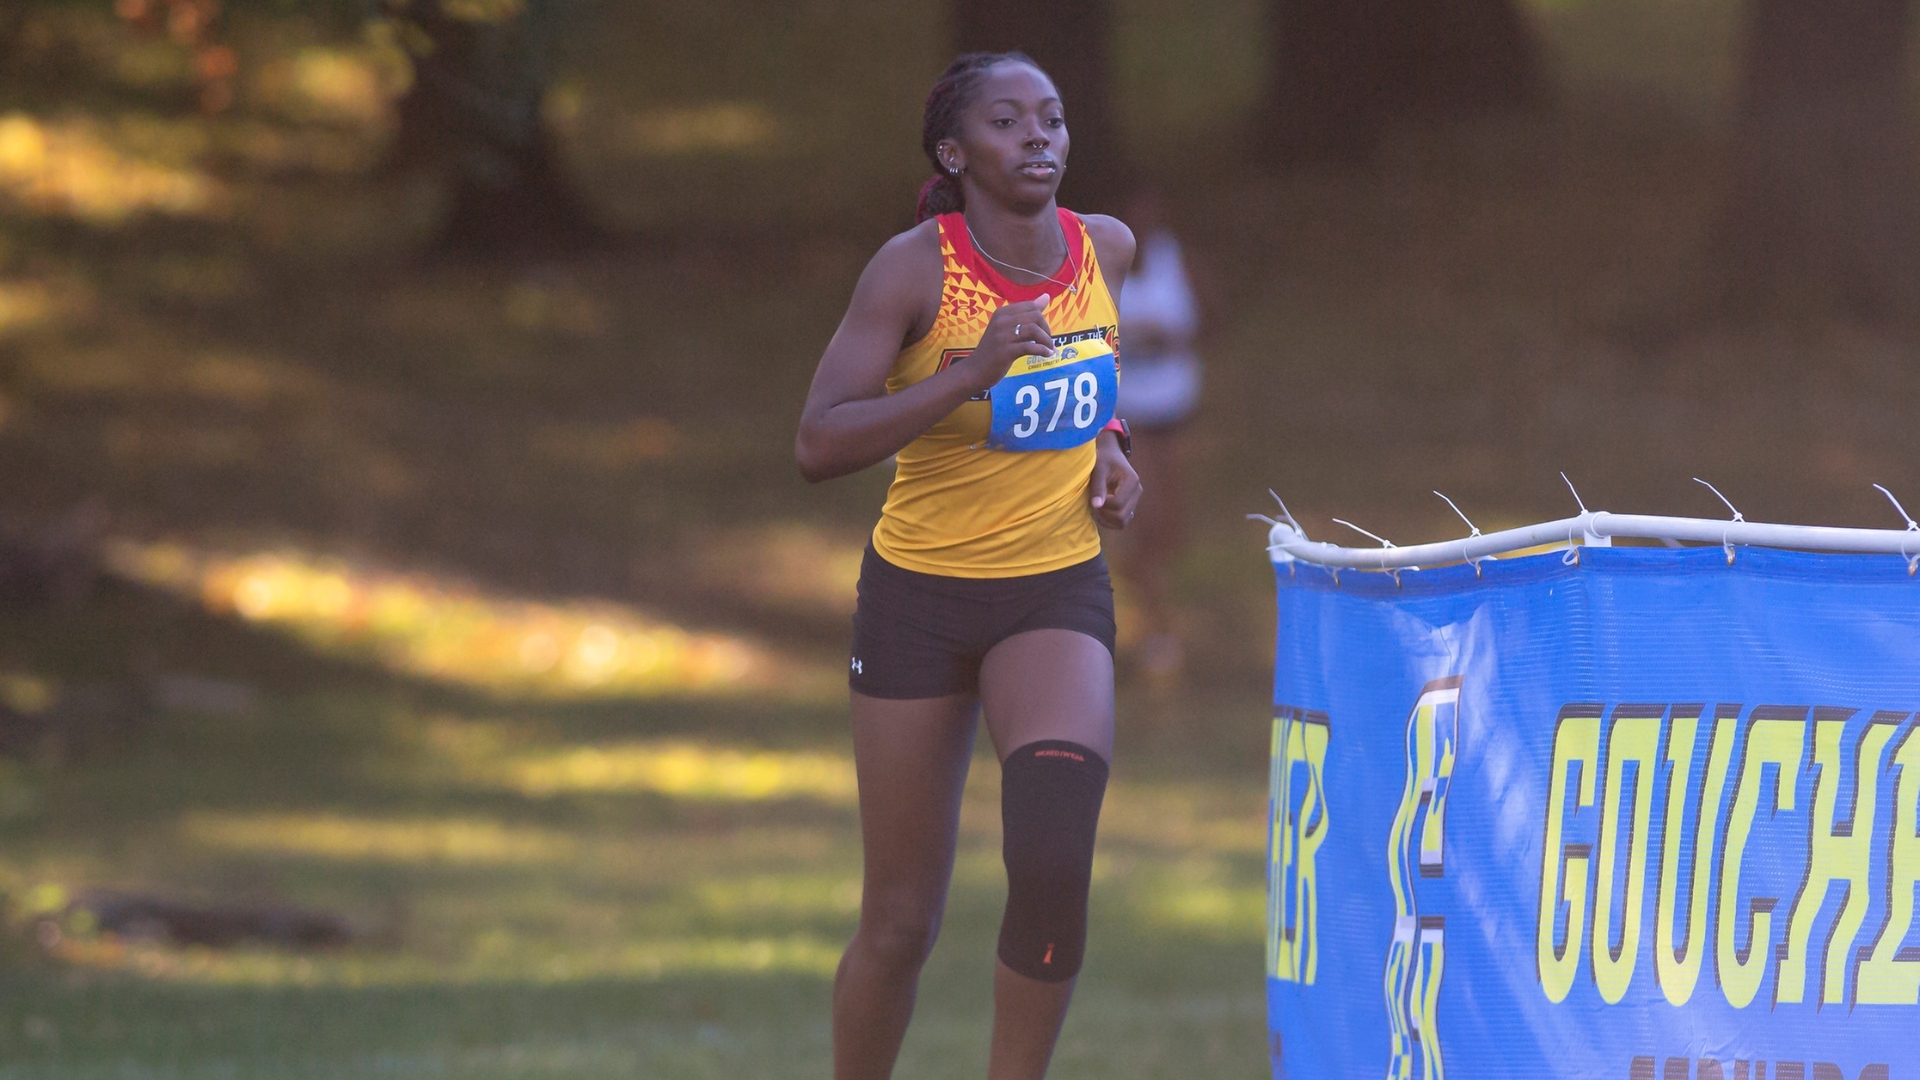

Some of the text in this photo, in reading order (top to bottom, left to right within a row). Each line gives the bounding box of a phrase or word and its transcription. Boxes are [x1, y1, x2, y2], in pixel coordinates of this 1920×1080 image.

[1071, 334, 1084, 344] OF
[1087, 330, 1104, 340] THE
[1013, 371, 1099, 439] 378
